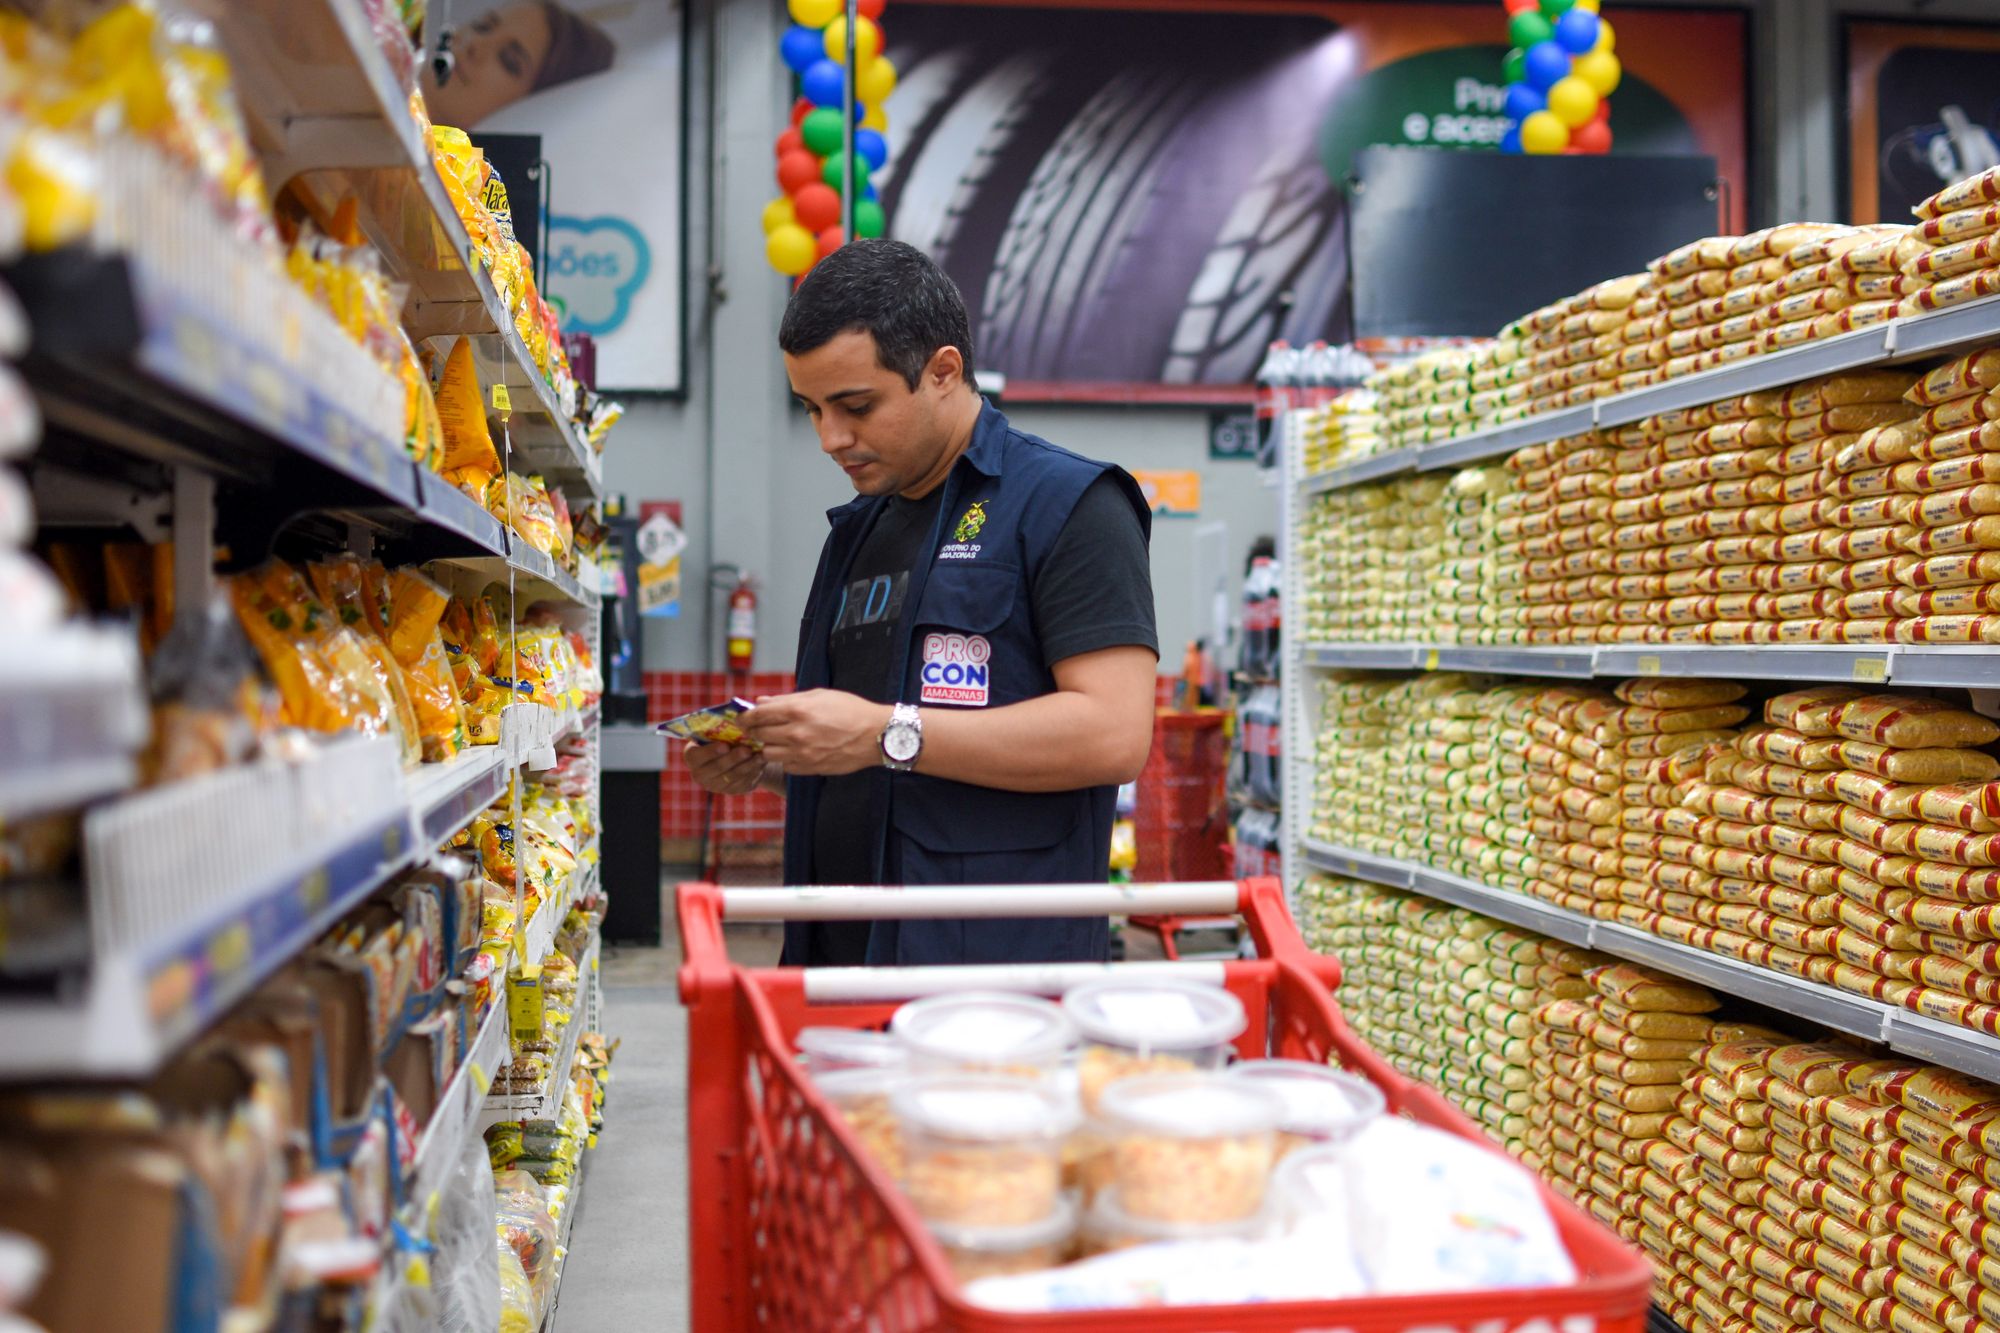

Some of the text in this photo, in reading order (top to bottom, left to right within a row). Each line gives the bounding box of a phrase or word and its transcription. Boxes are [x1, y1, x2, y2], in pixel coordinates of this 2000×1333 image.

[1455, 77, 1510, 111] Pn
[1402, 113, 1428, 142] e
[970, 544, 982, 552] DO
[924, 634, 990, 663] PRO
[923, 662, 986, 687] CON
[925, 687, 984, 701] AMAZONAS
